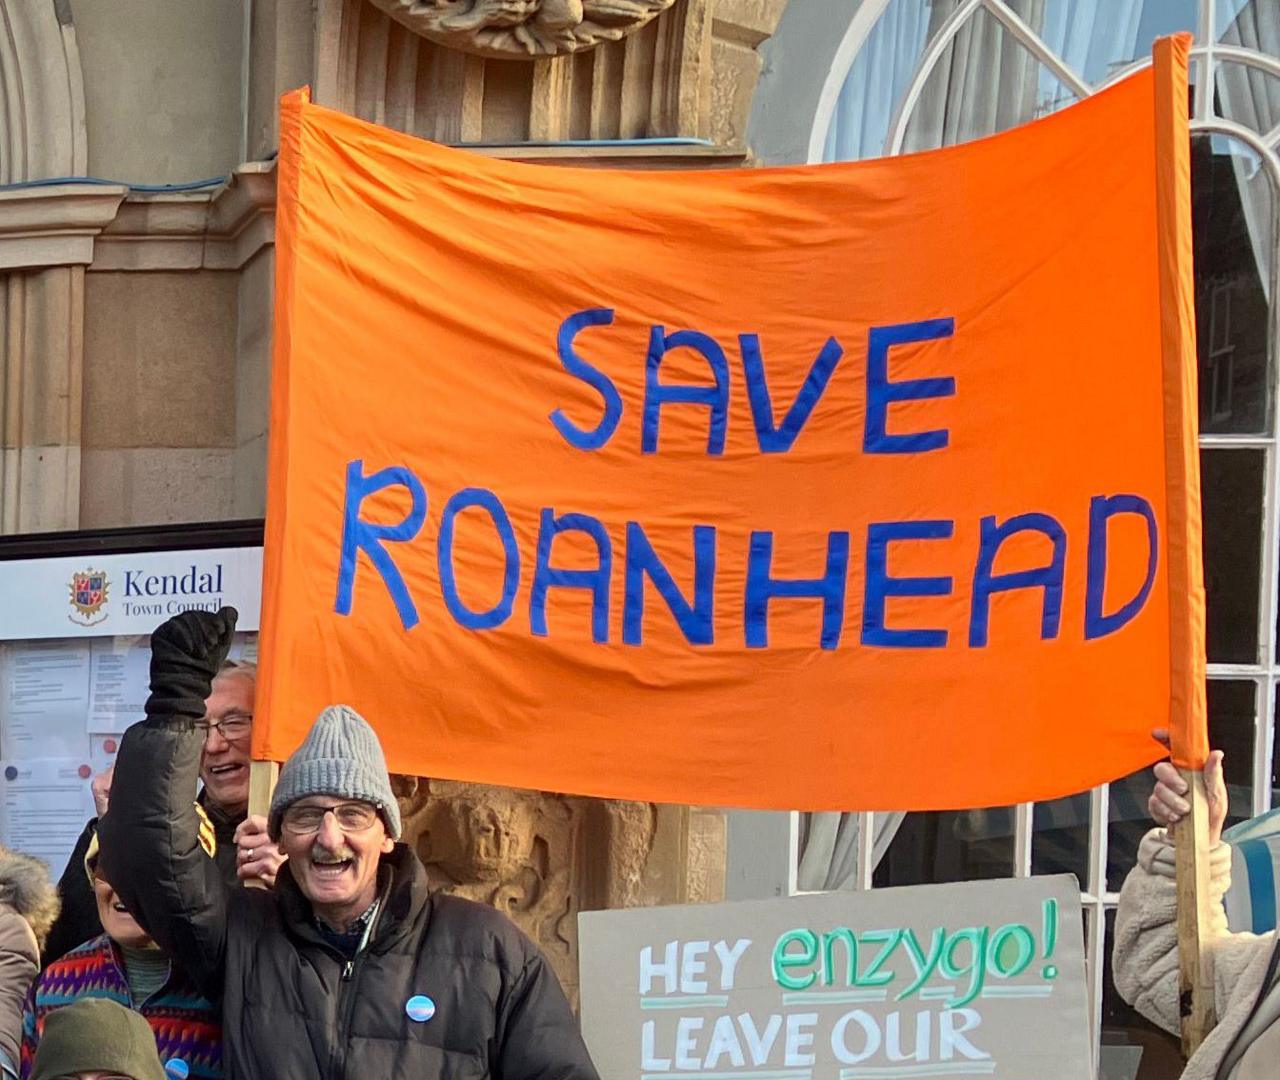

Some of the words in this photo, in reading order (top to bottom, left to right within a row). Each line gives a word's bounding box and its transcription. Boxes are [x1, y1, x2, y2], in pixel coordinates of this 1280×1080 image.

[549, 309, 955, 456] SAVE
[123, 564, 223, 597] Kendal
[334, 459, 1158, 651] ROANHEAD
[123, 602, 162, 616] Town
[639, 938, 751, 995] HEY
[772, 898, 1058, 1009] enzygo!
[640, 1011, 818, 1071] LEAVE
[831, 1008, 990, 1064] OUR
